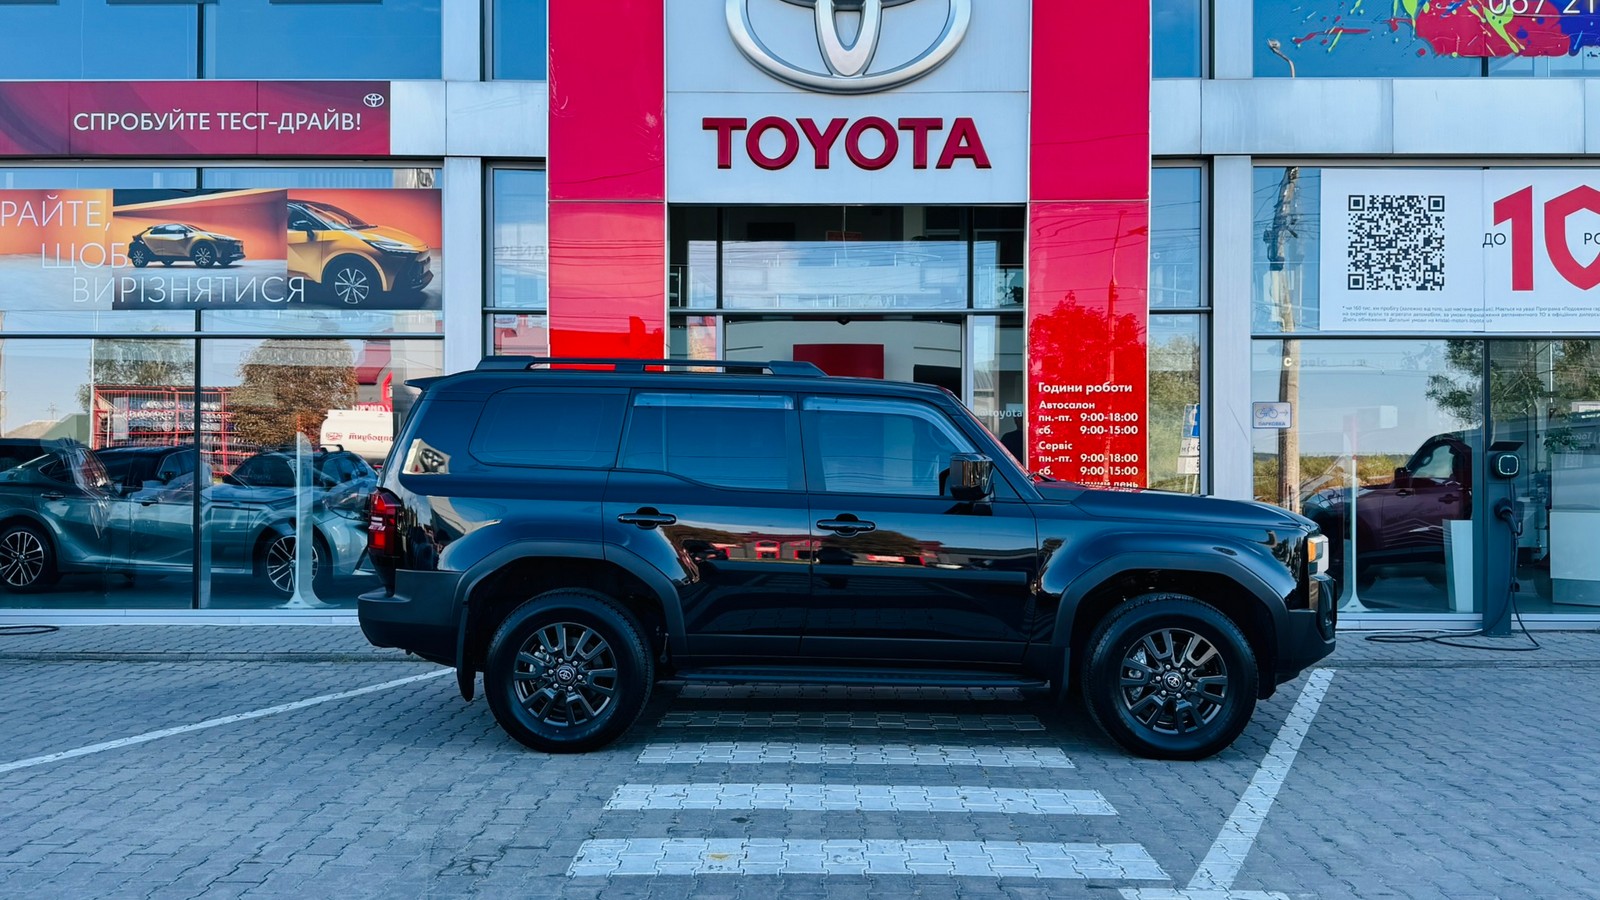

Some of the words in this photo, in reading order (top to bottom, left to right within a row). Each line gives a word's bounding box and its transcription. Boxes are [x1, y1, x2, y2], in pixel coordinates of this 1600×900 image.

[73, 108, 210, 132] СПРОБУЙТЕ
[216, 108, 361, 134] ТЕСТ-ДРАЙВ!
[702, 116, 992, 171] TOYOTA
[1482, 232, 1506, 248] ДО
[41, 242, 129, 274] ЩОБ
[73, 276, 305, 303] ВИРІЗНЯТИСЯ
[1038, 381, 1083, 394] Години
[1085, 381, 1133, 395] роботи
[1039, 400, 1095, 410] Автосалон
[1038, 414, 1073, 422] пн.-пт.
[1080, 413, 1138, 422] 9:00-18:00
[1038, 425, 1054, 435] сб.
[1080, 425, 1138, 435] 9:00-15:00
[1038, 440, 1073, 452] Сервіс
[1038, 455, 1073, 463] пн.-пт.
[1080, 454, 1138, 463] 9:00-18:00
[1038, 466, 1054, 475] сб.
[1080, 466, 1138, 476] 9:00-15:00
